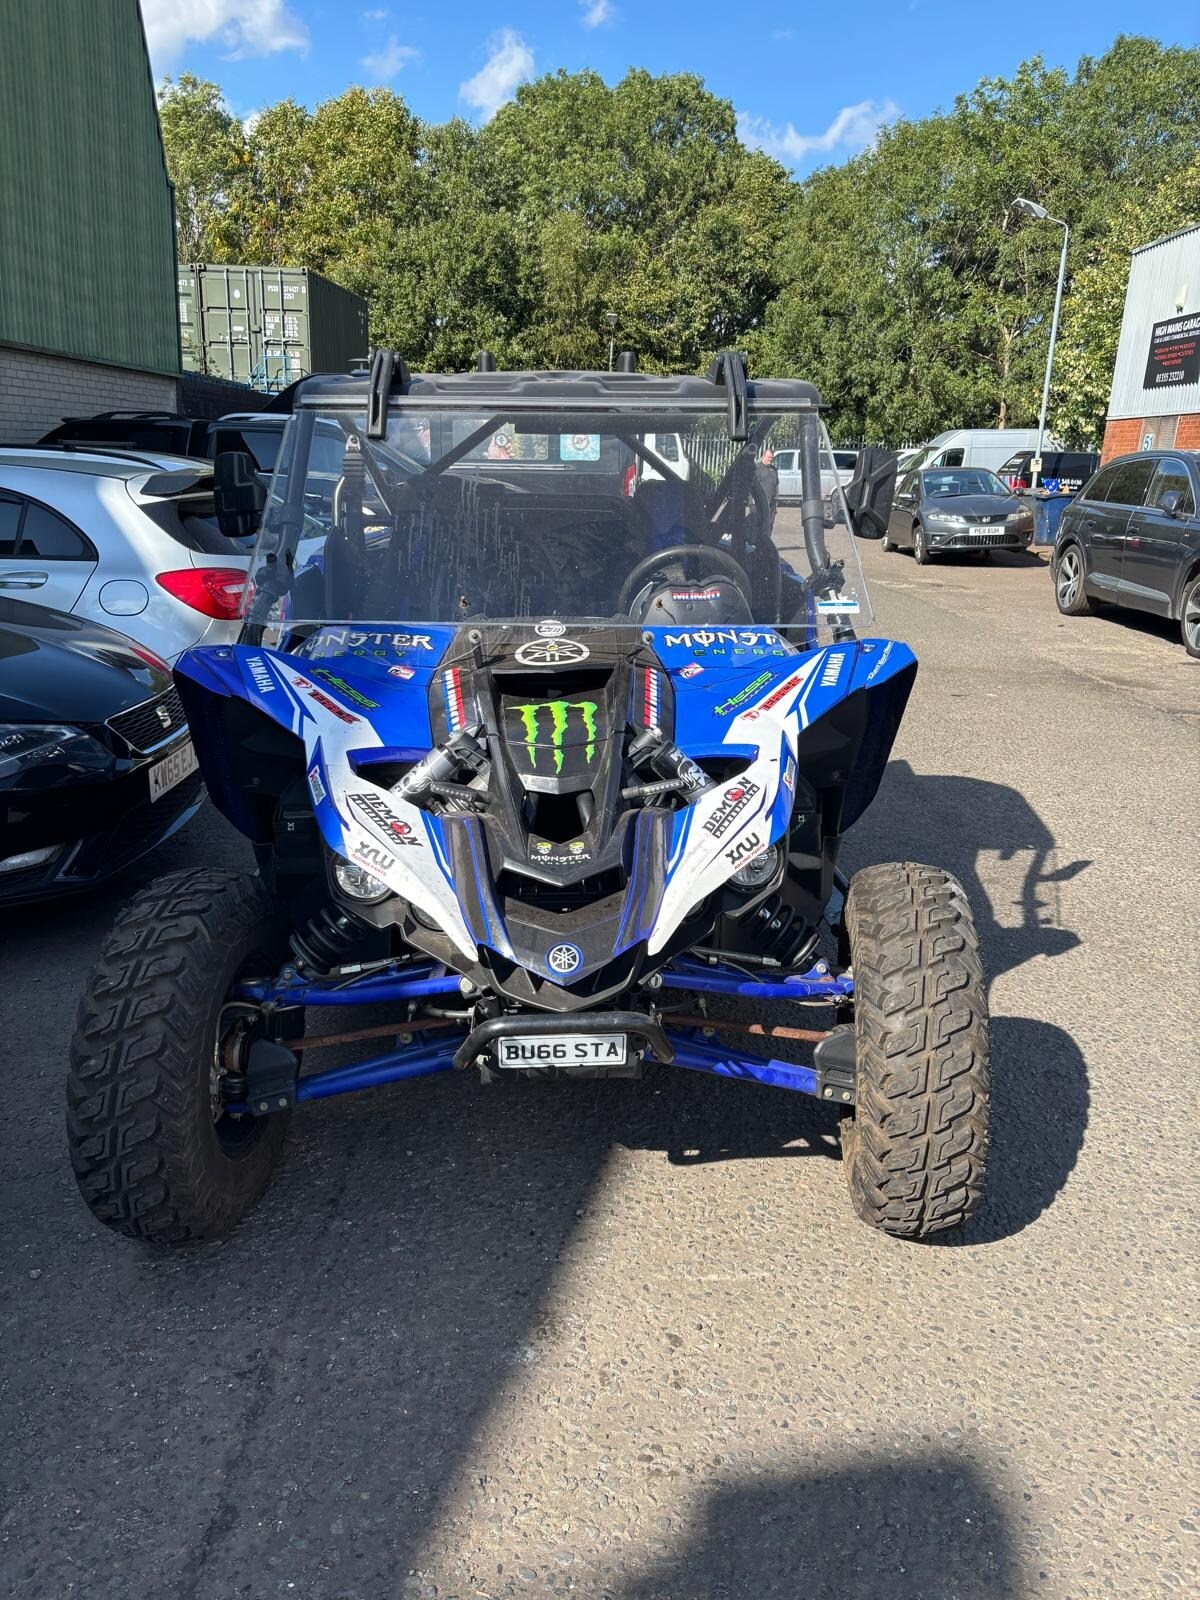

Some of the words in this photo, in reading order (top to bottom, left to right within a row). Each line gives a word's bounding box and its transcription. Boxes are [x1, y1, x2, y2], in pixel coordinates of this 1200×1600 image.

[1155, 326, 1167, 337] HIGH
[1167, 321, 1183, 334] MAINS
[304, 631, 434, 652] ONSTER
[664, 629, 778, 648] MONST
[311, 650, 408, 660] NERGY
[694, 648, 785, 657] ENERG
[245, 656, 276, 694] YAMAHA
[820, 653, 846, 687] YAMAHA
[181, 745, 197, 772] EJ
[702, 776, 752, 834] DEMON
[363, 792, 424, 847] DEMON
[530, 853, 592, 863] MONSTER
[505, 1043, 567, 1060] BU66
[574, 1042, 619, 1058] STA
